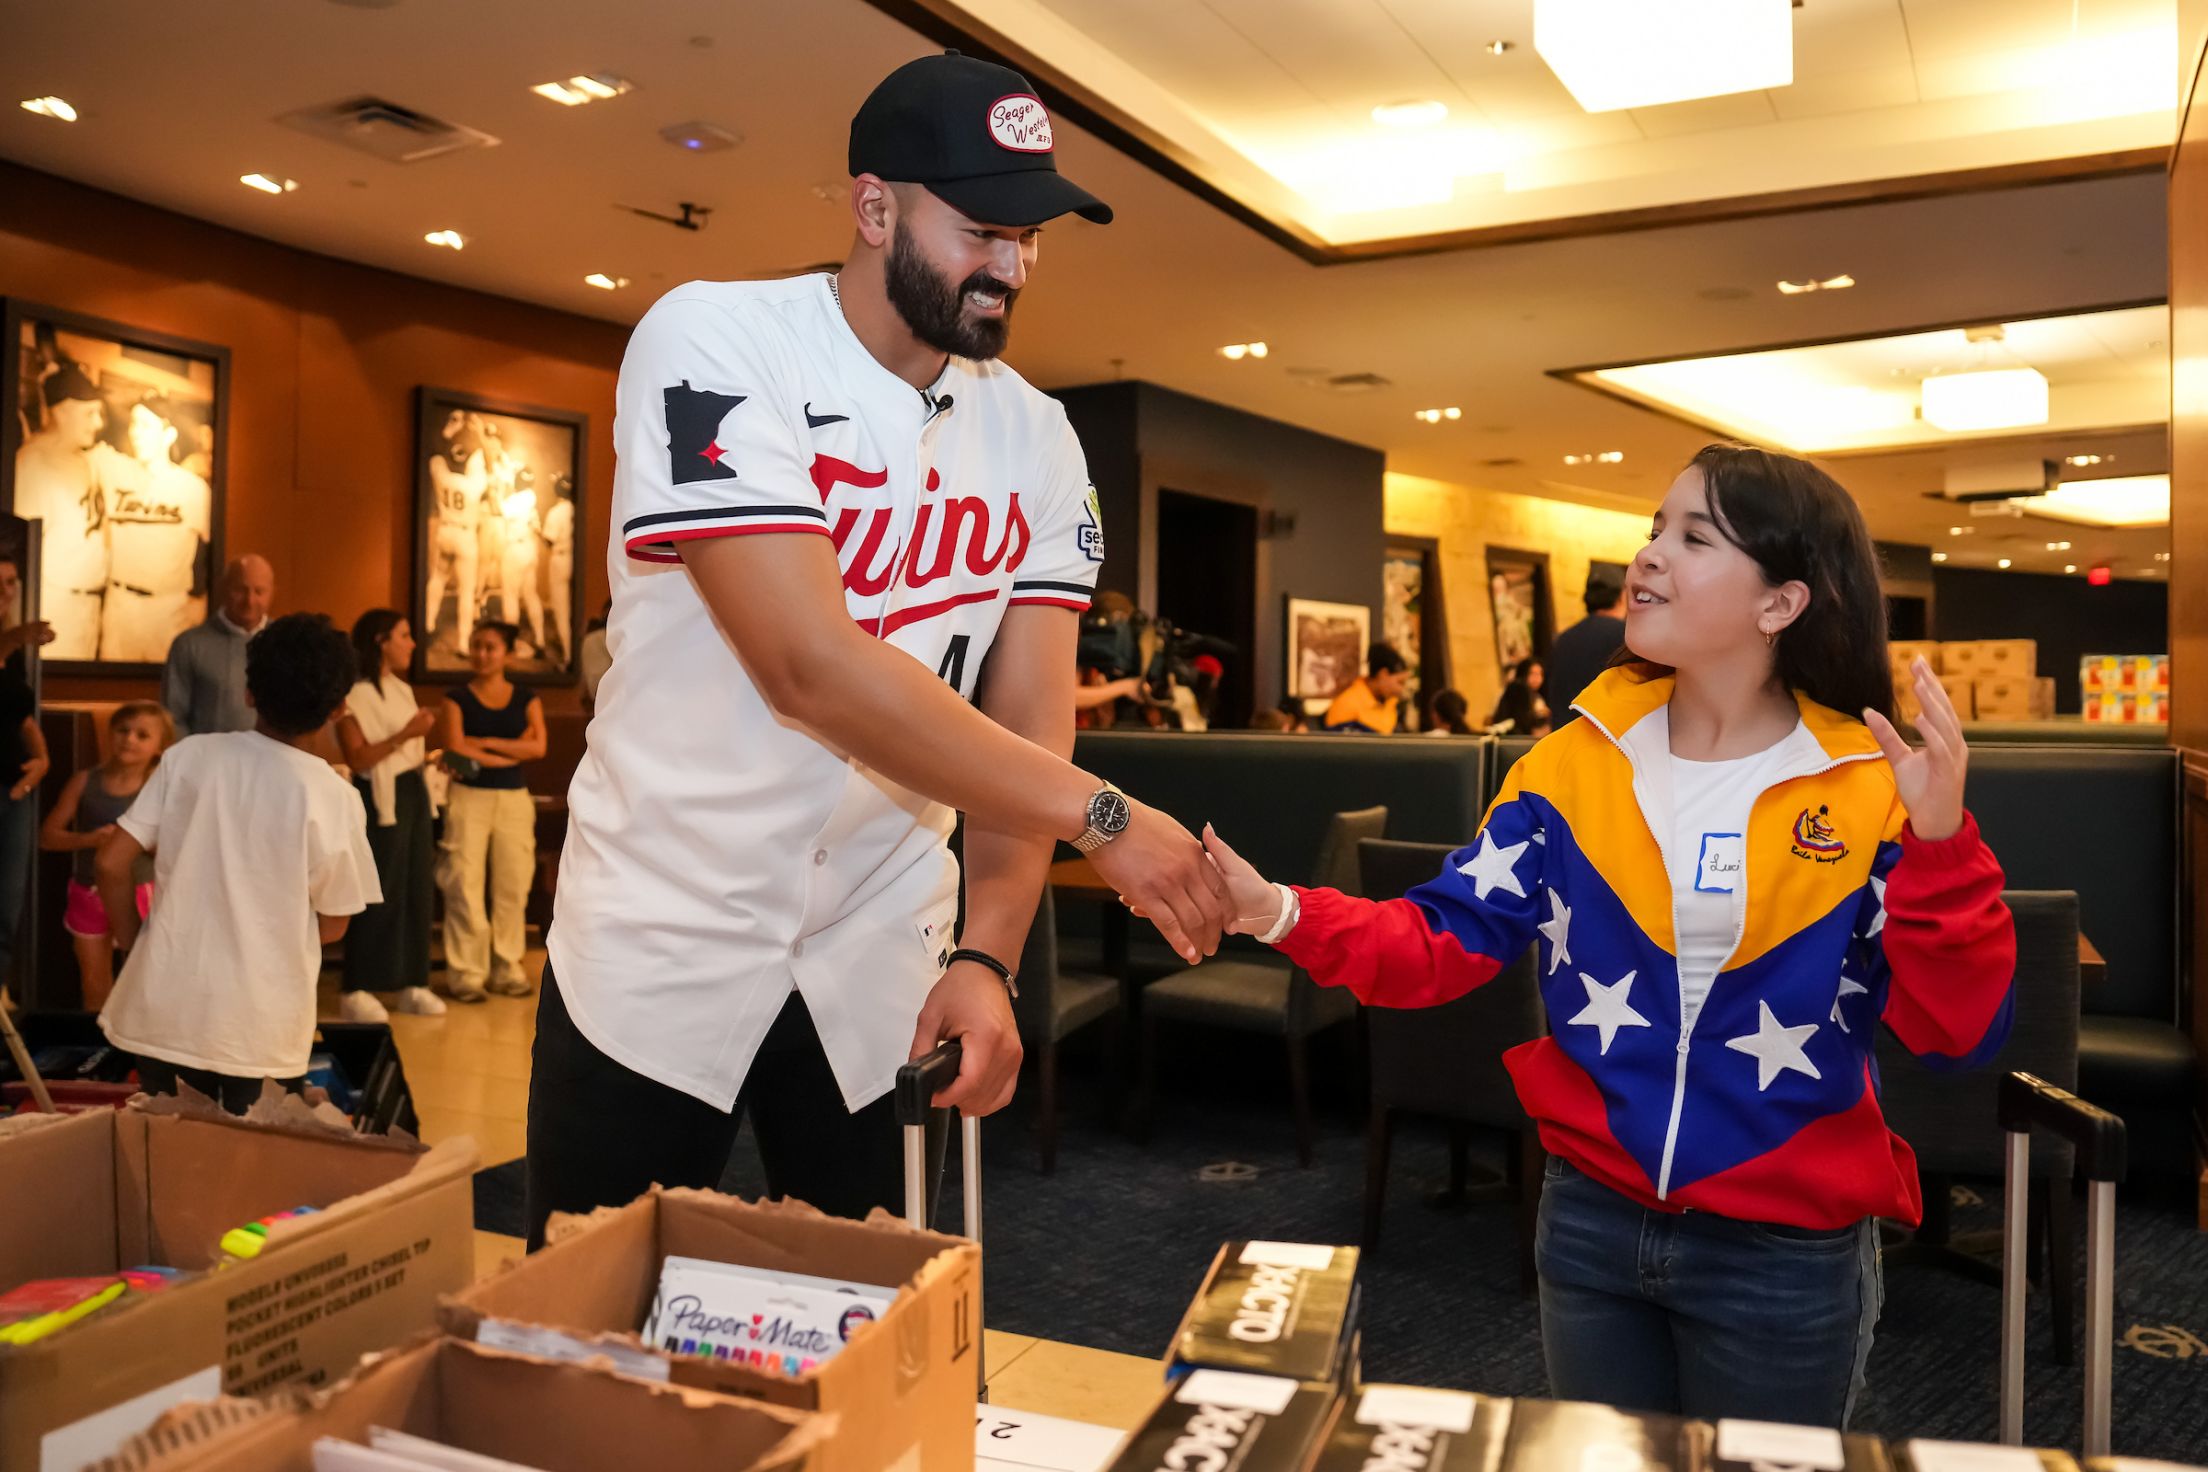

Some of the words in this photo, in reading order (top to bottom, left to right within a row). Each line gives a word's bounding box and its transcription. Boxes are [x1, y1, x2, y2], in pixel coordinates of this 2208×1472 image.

[993, 103, 1034, 128] Seager
[442, 487, 465, 511] 18
[809, 453, 1031, 598] Twins
[226, 1301, 281, 1335] POCKET
[283, 1264, 369, 1311] HIGHLIGHTER
[412, 1237, 431, 1255] TIP
[226, 1305, 321, 1360] FLUORESCENT
[324, 1283, 374, 1317] COLORS
[668, 1294, 748, 1337] Paper
[757, 1315, 831, 1353] Mate
